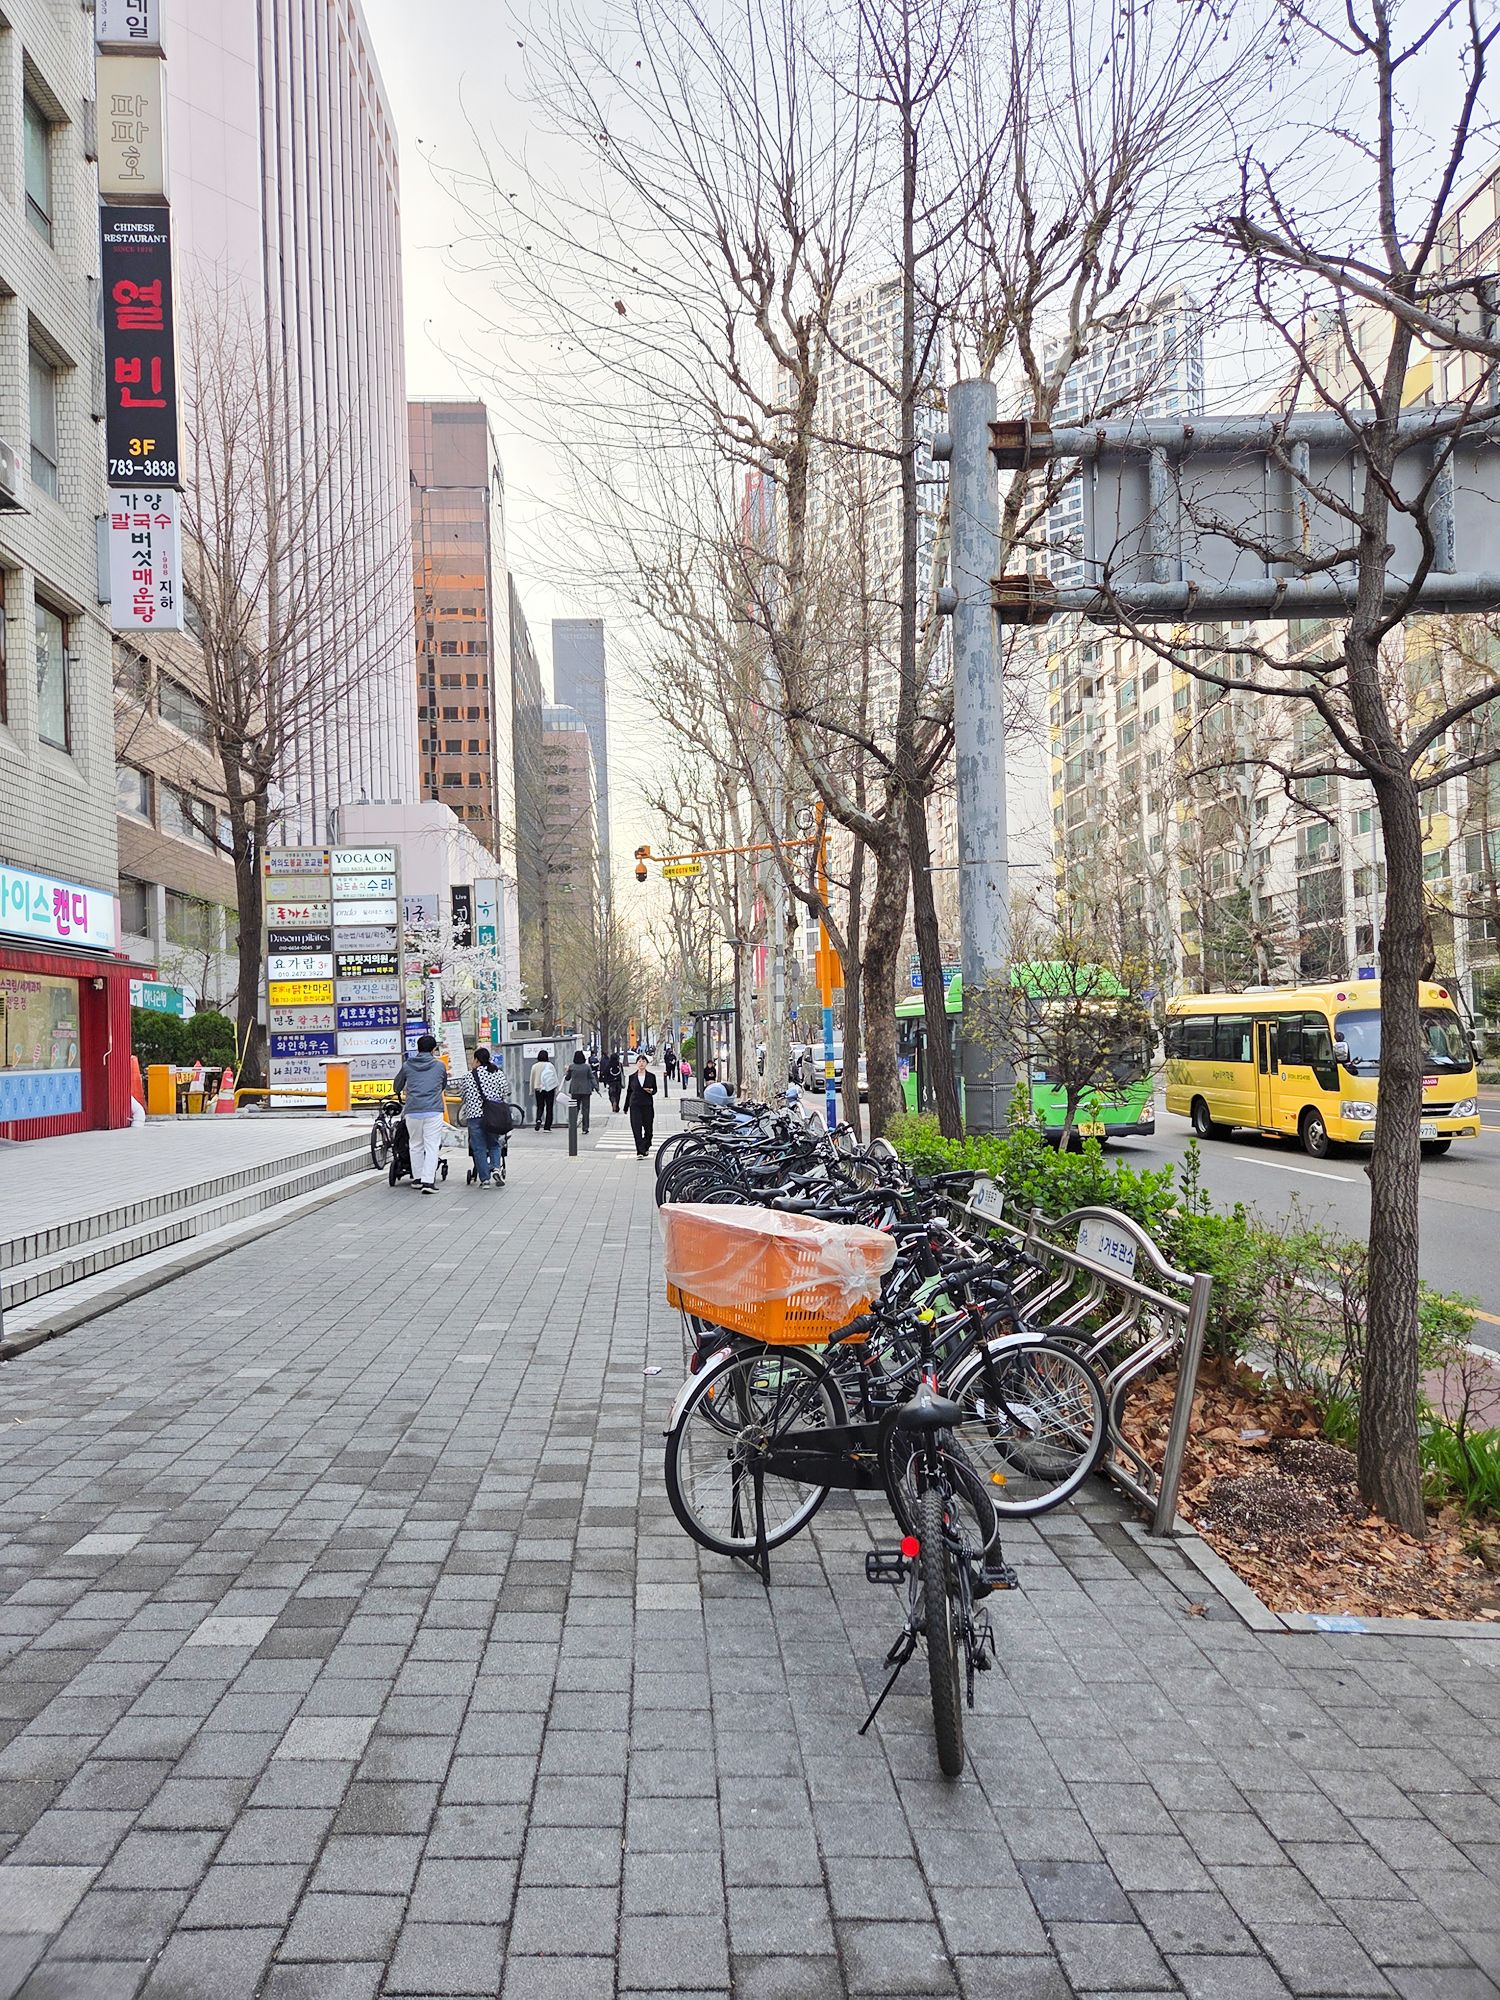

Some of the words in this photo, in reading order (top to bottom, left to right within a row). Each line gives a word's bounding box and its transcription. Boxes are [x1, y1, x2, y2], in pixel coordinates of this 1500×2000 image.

[113, 223, 155, 232] CHINESE
[104, 233, 167, 243] RESTAURANT
[112, 279, 167, 408] 열빈
[129, 438, 156, 456] 3F
[109, 459, 176, 477] 783-3838
[119, 494, 162, 511] 가양
[111, 513, 172, 530] 칼국수
[160, 580, 173, 610] 지하
[335, 853, 372, 864] YOGA
[374, 853, 392, 863] ON
[270, 934, 300, 943] Dasom
[273, 957, 315, 970] 요가람
[353, 983, 379, 995] 장지은
[381, 983, 398, 993] 내과
[274, 1015, 295, 1026] 명동
[277, 1040, 329, 1051] 와인하우스
[343, 1037, 369, 1046] Muse
[361, 1059, 396, 1069] 마음수련
[1098, 1236, 1134, 1266] 거보관소
